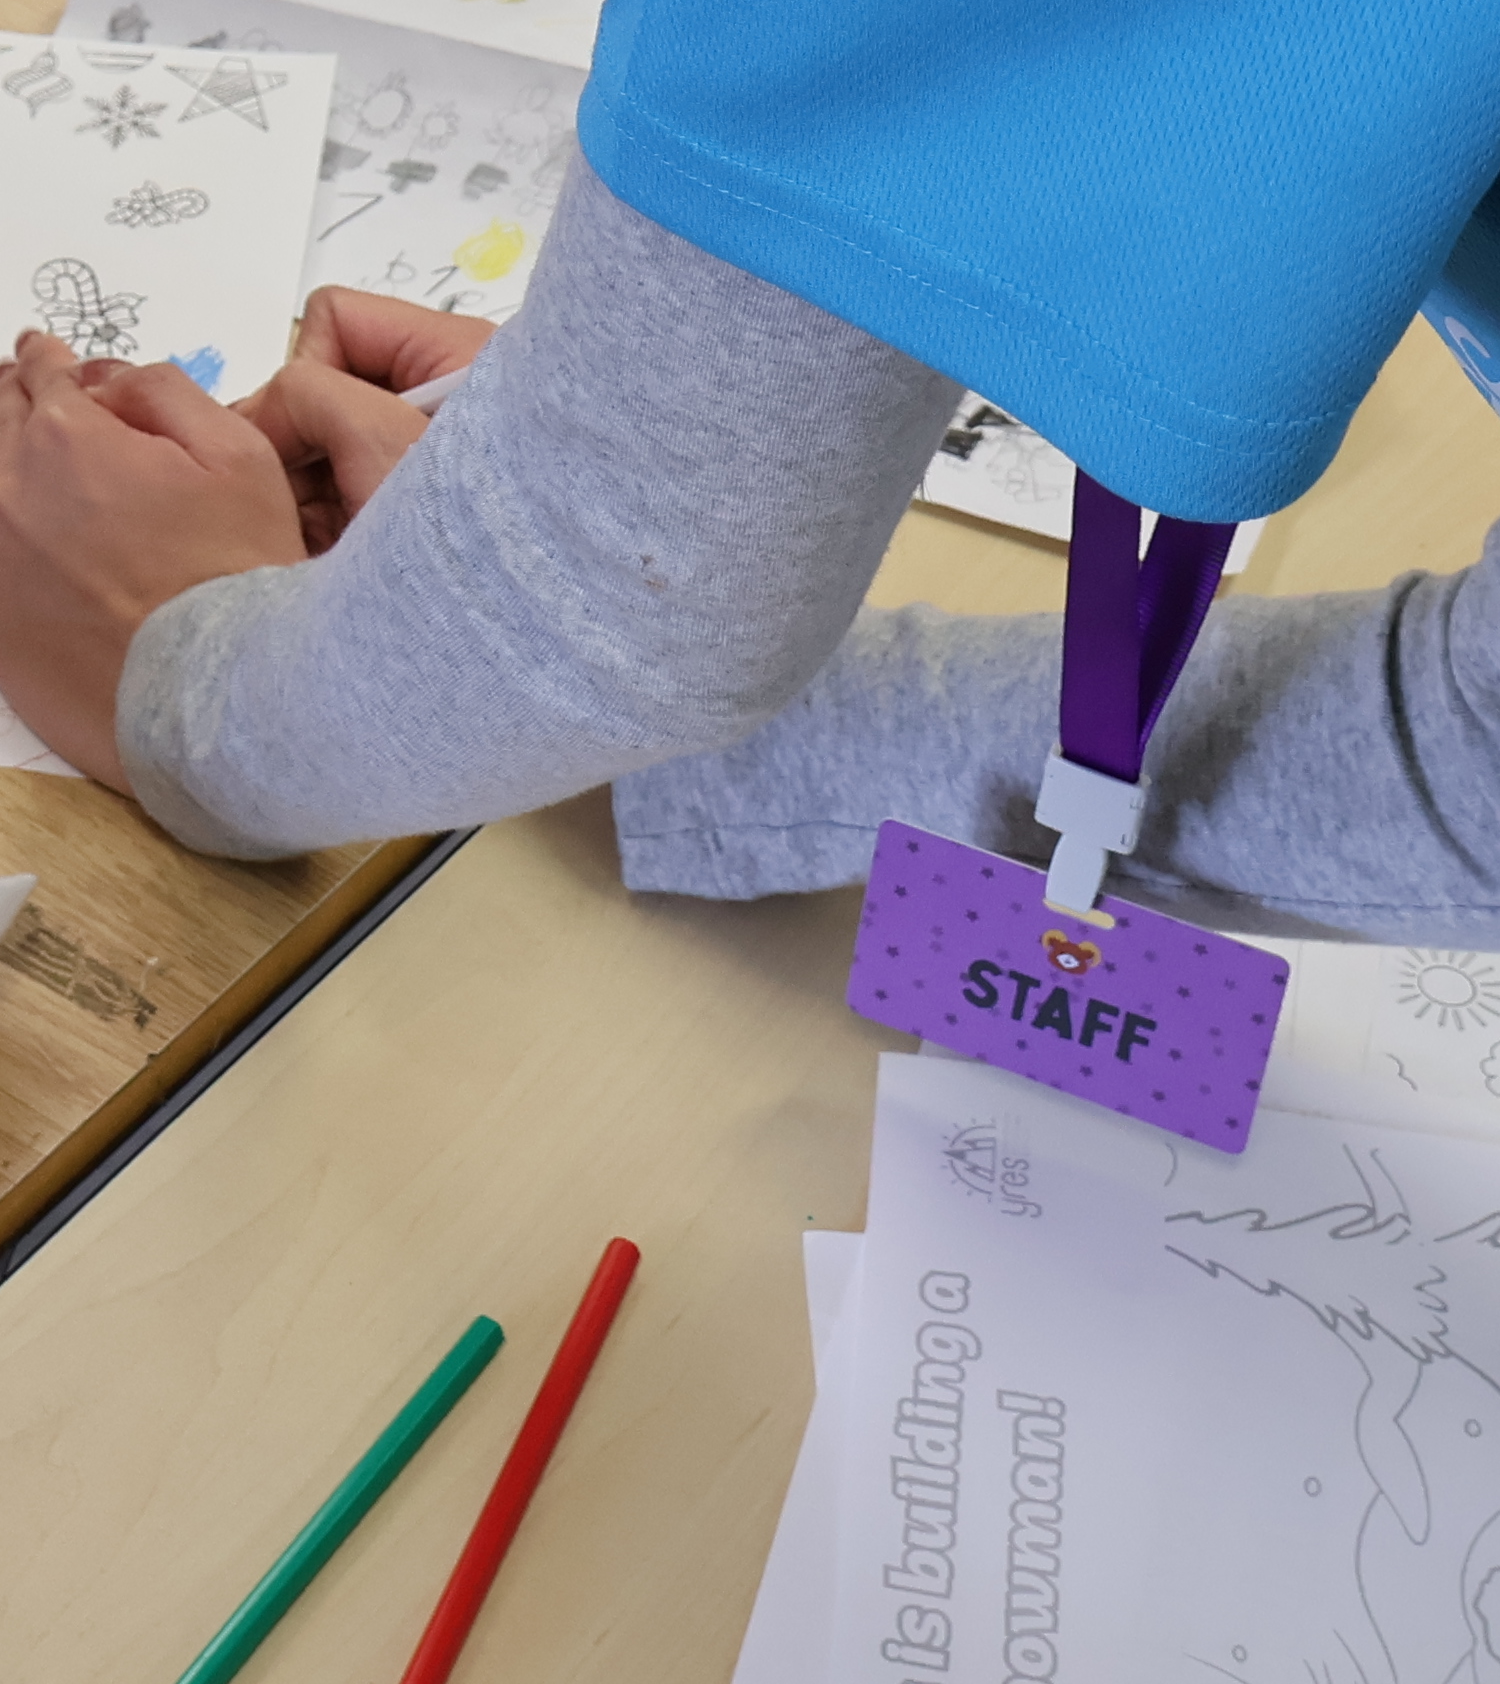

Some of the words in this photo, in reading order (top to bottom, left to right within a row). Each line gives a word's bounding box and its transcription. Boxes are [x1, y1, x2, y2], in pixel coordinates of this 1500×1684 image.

[961, 958, 1158, 1065] STAFF
[917, 1268, 972, 1315] a
[882, 1320, 983, 1600] building
[996, 1387, 1067, 1684] owman!
[880, 1603, 953, 1672] is
